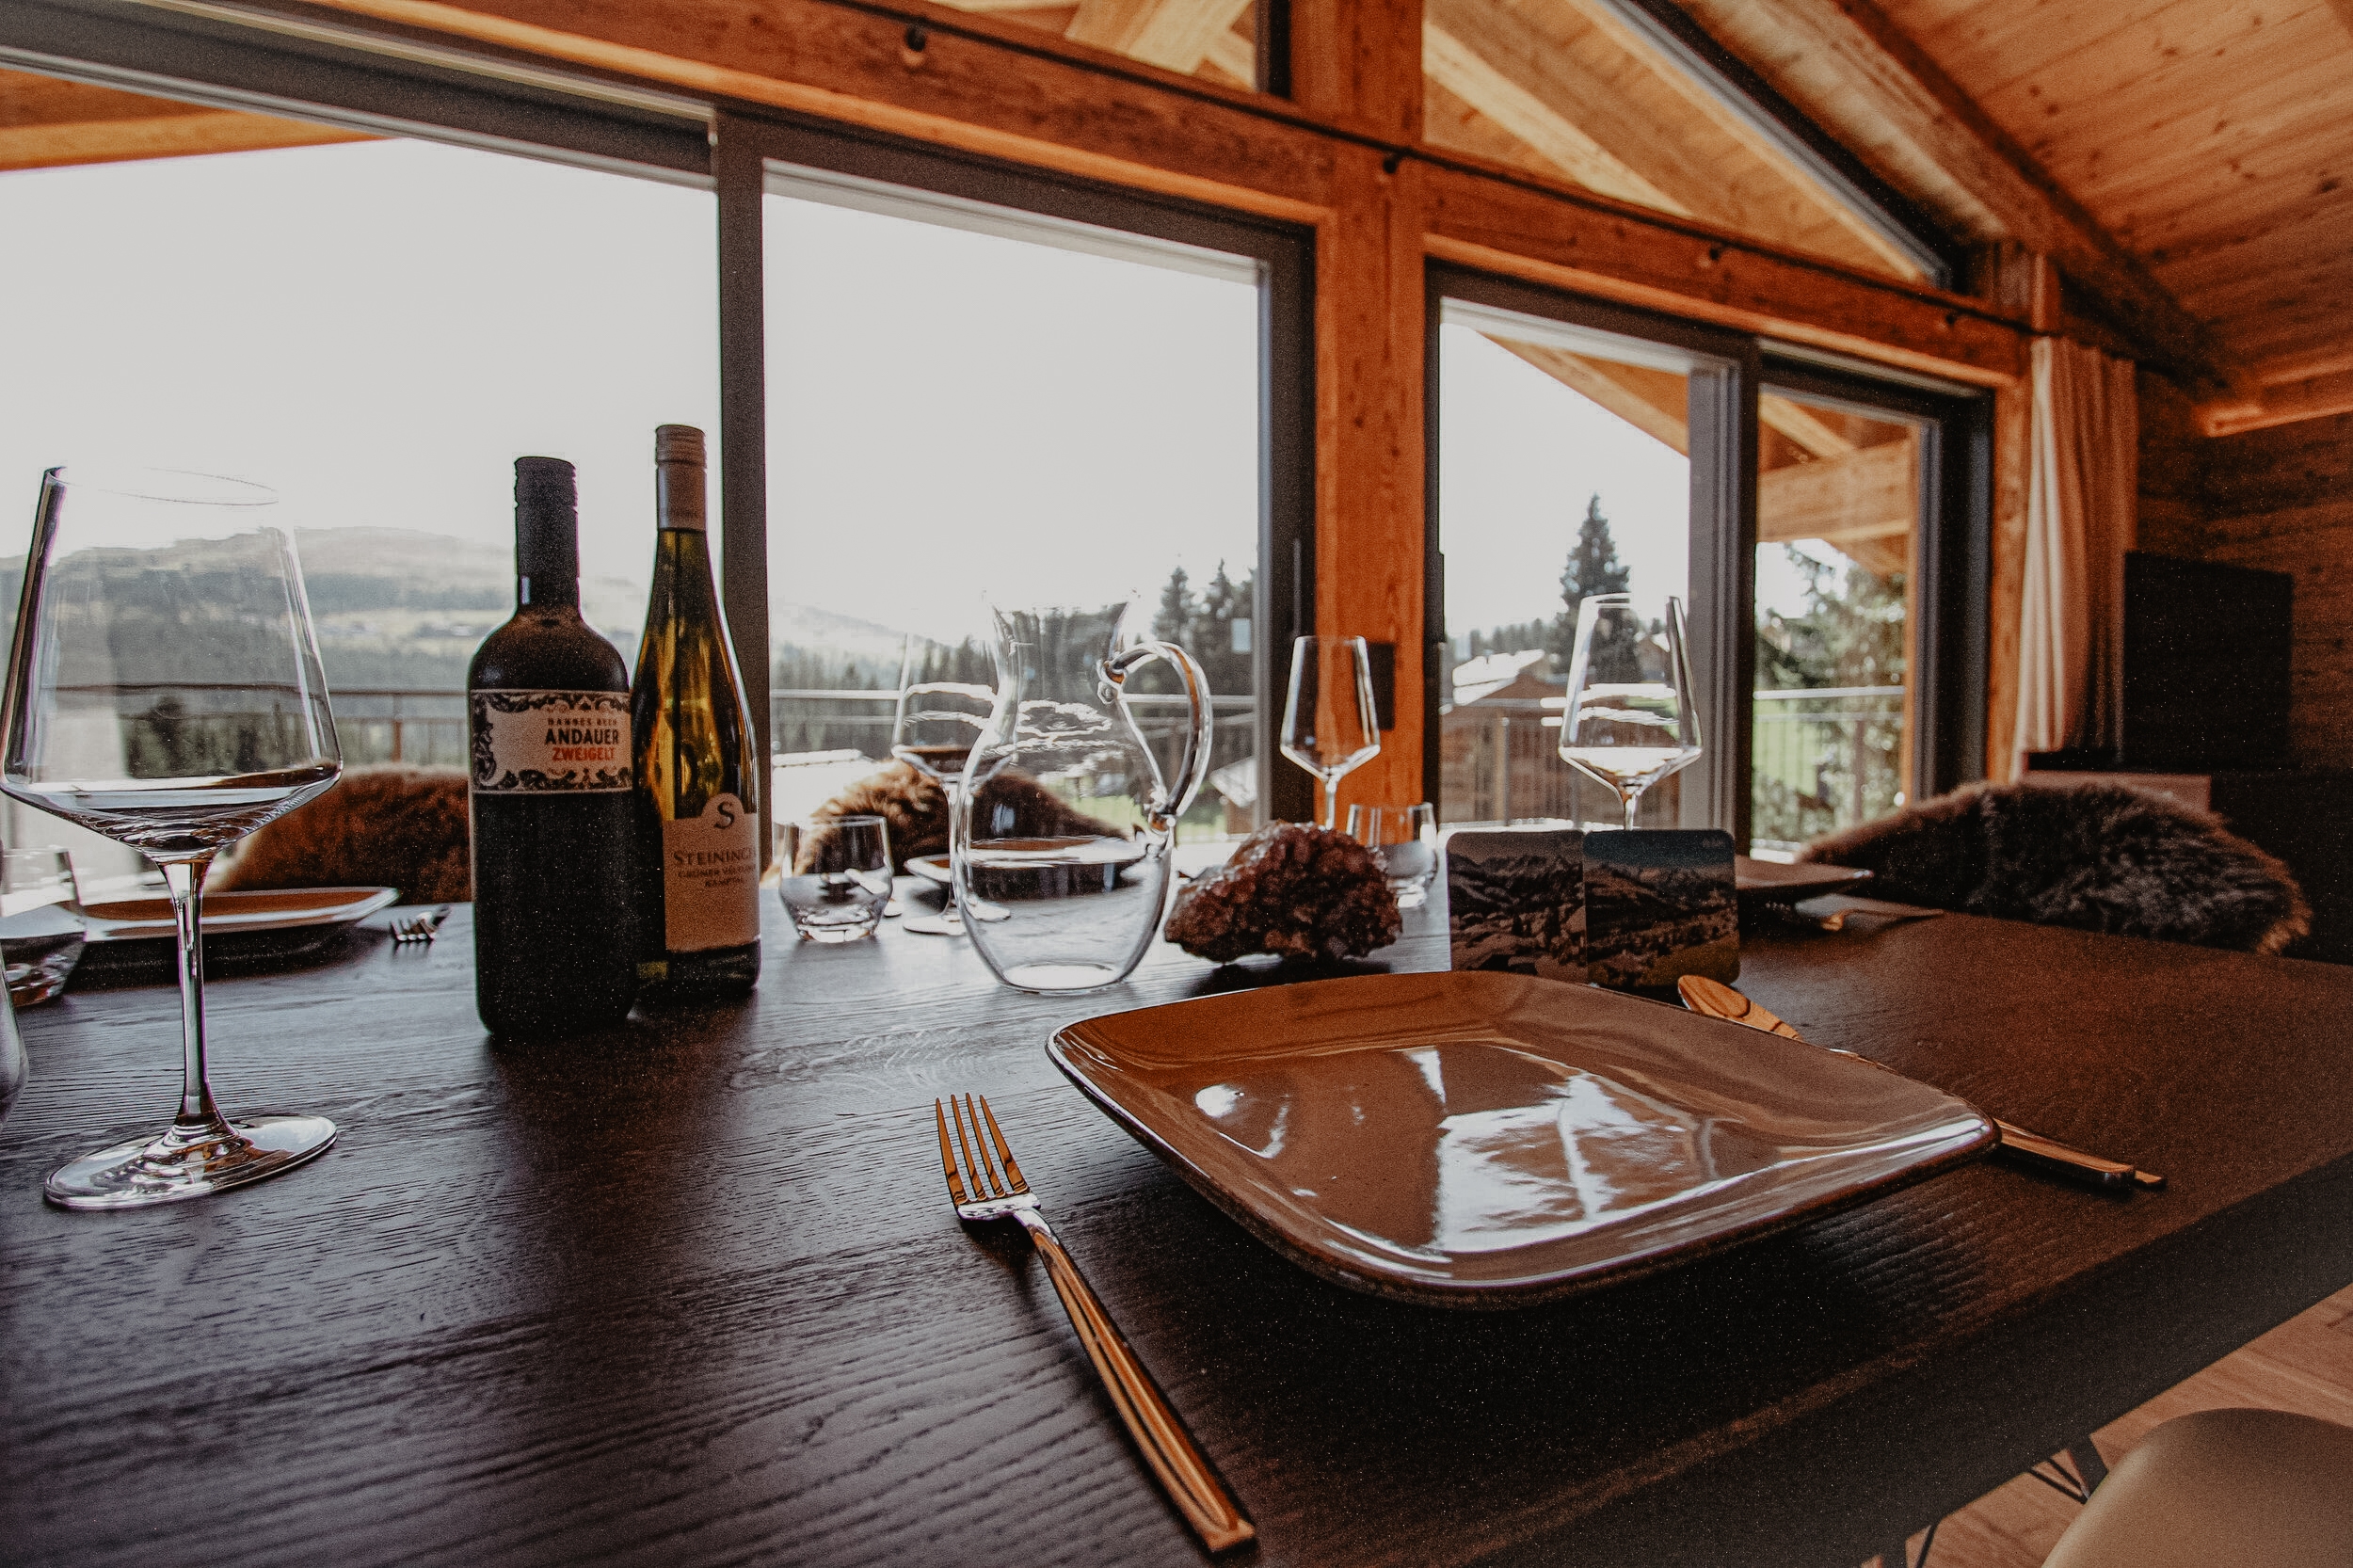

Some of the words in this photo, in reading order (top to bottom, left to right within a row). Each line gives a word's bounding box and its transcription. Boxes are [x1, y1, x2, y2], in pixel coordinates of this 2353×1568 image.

[545, 728, 619, 745] ANDAUER
[552, 746, 616, 761] ZWEIGELT
[713, 801, 735, 830] S
[673, 846, 755, 867] STEINING
